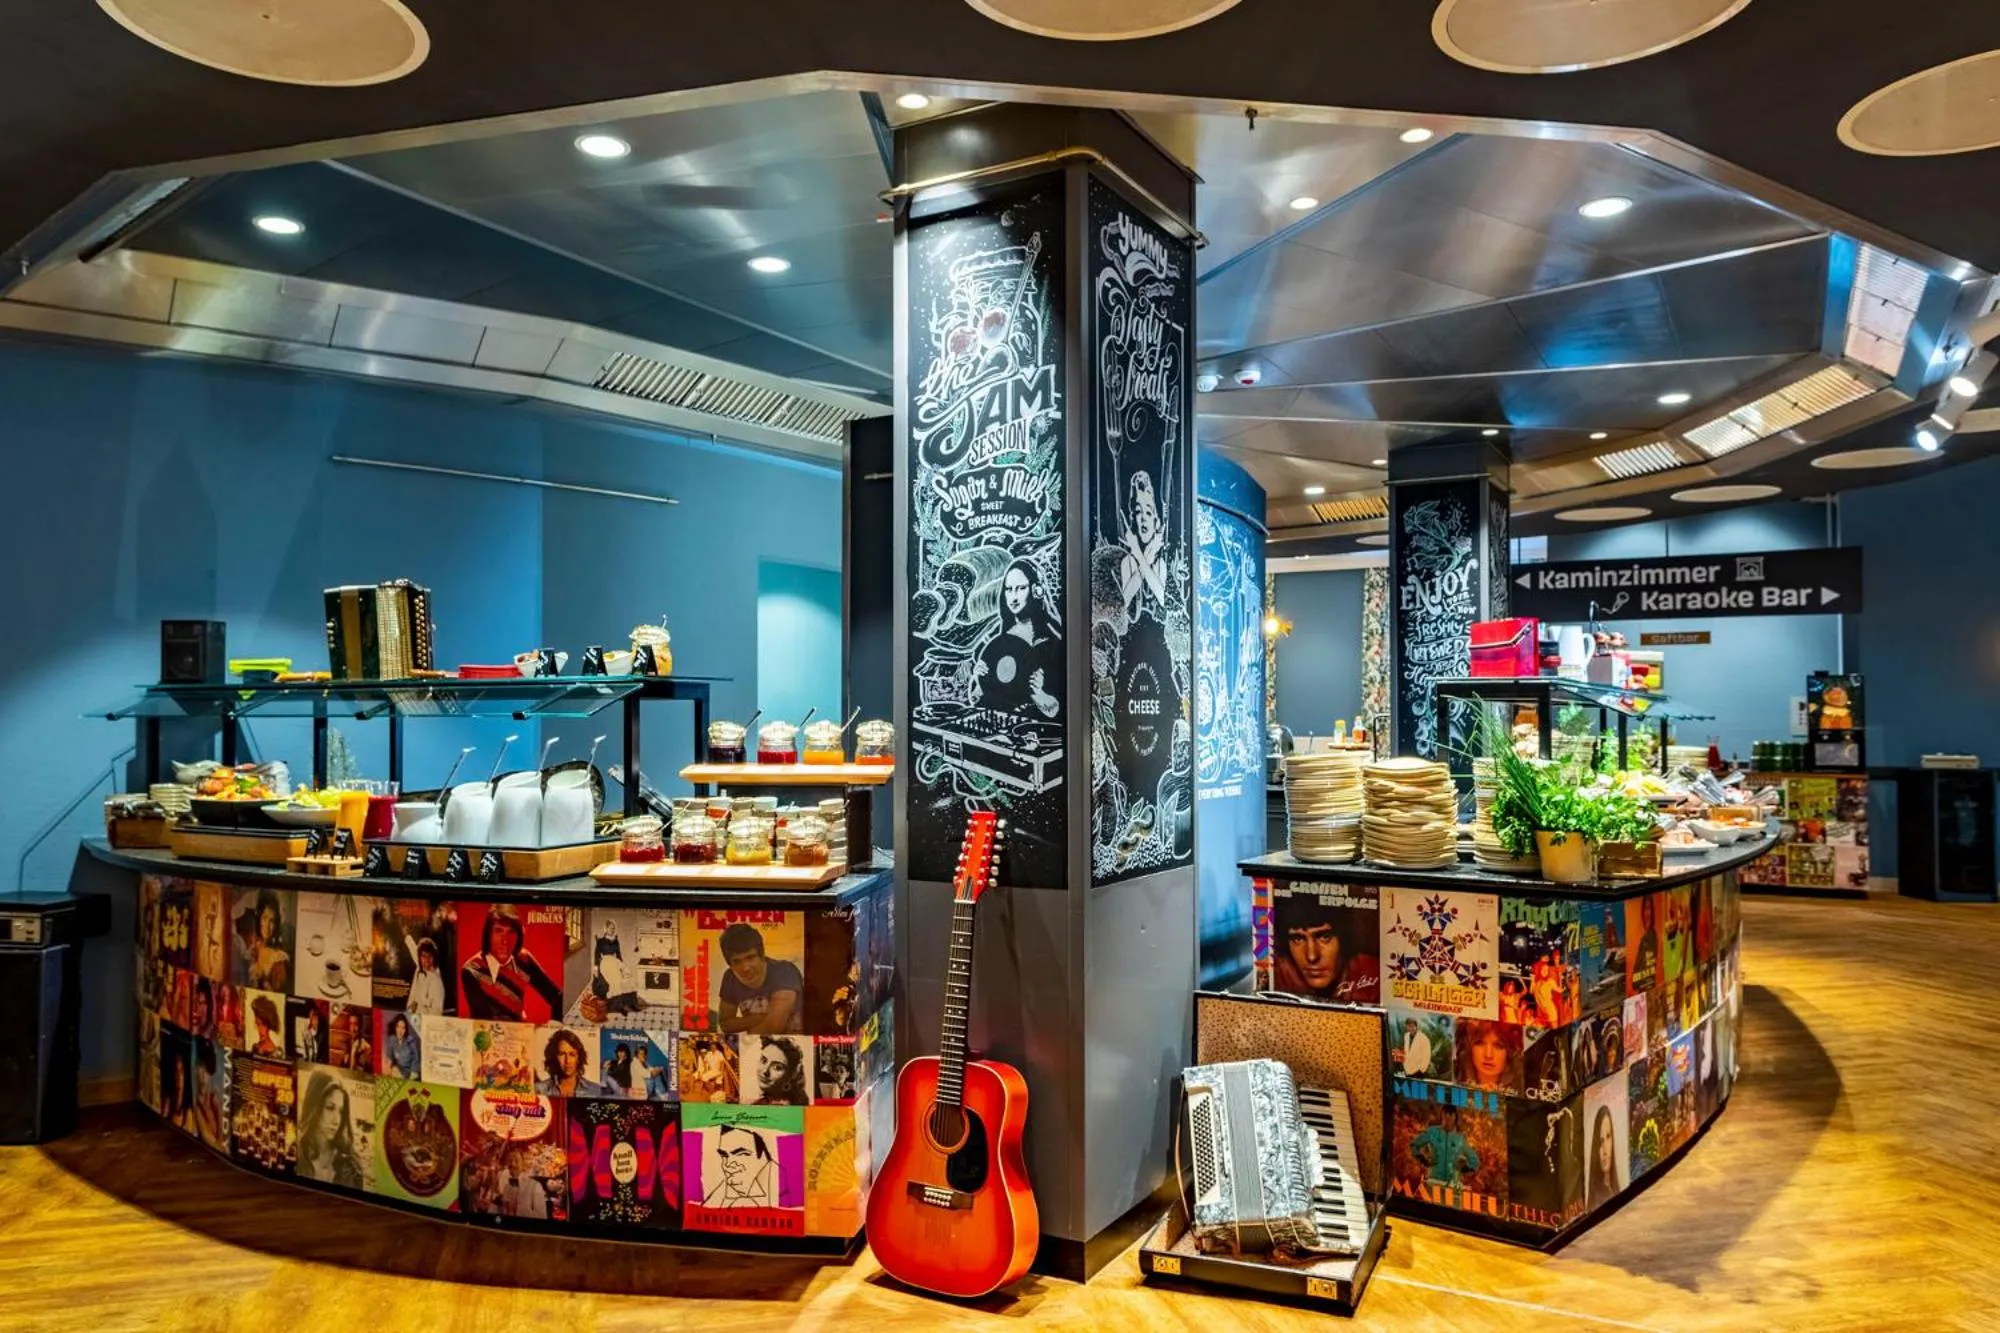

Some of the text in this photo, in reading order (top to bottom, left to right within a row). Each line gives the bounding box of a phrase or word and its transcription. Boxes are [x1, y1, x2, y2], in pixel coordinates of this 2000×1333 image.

[969, 419, 1028, 465] SESSION
[967, 514, 1022, 530] BREAKFAST
[1400, 559, 1479, 616] ENJOY
[1538, 564, 1721, 591] Kaminzimmer
[1640, 585, 1813, 612] Karaoke Bar
[1128, 699, 1160, 715] CHEESE
